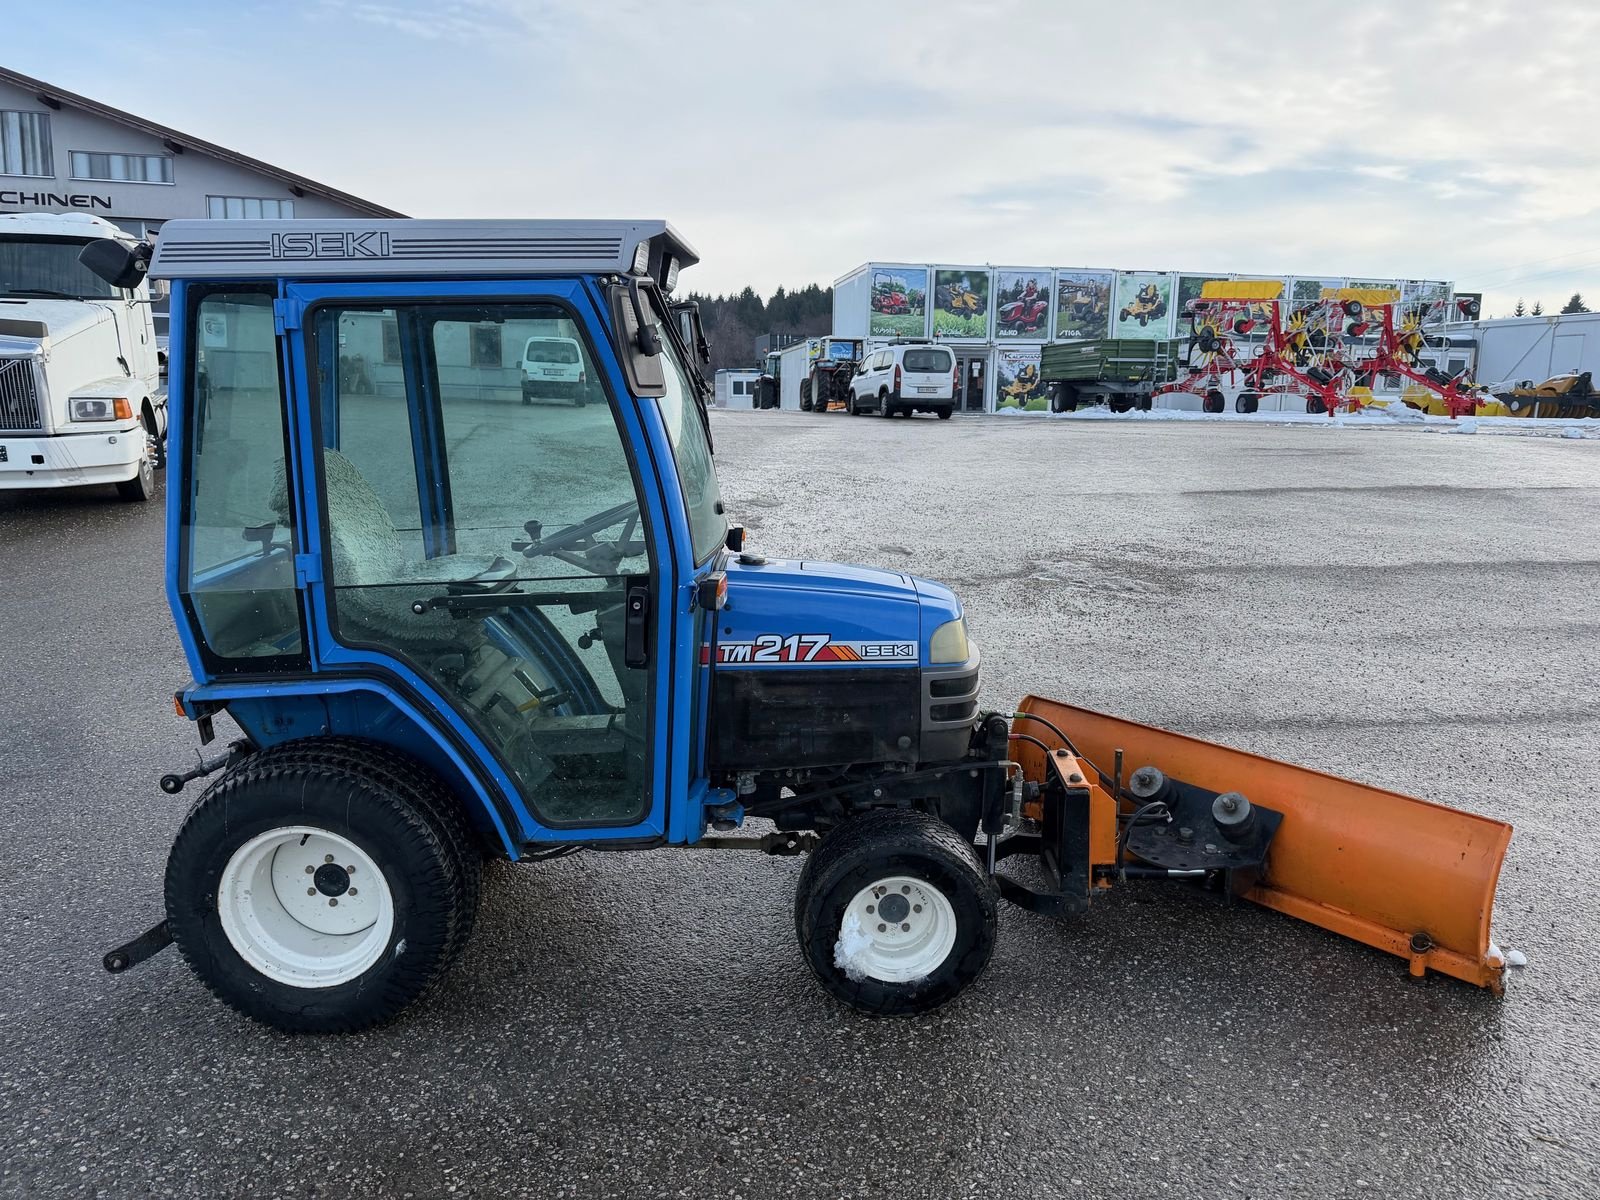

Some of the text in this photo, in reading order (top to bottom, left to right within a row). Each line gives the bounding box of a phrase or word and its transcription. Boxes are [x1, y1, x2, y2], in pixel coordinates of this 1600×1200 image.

[0, 190, 112, 209] CHINEN
[271, 231, 390, 258] ISEKI
[861, 644, 914, 657] ISEKI
